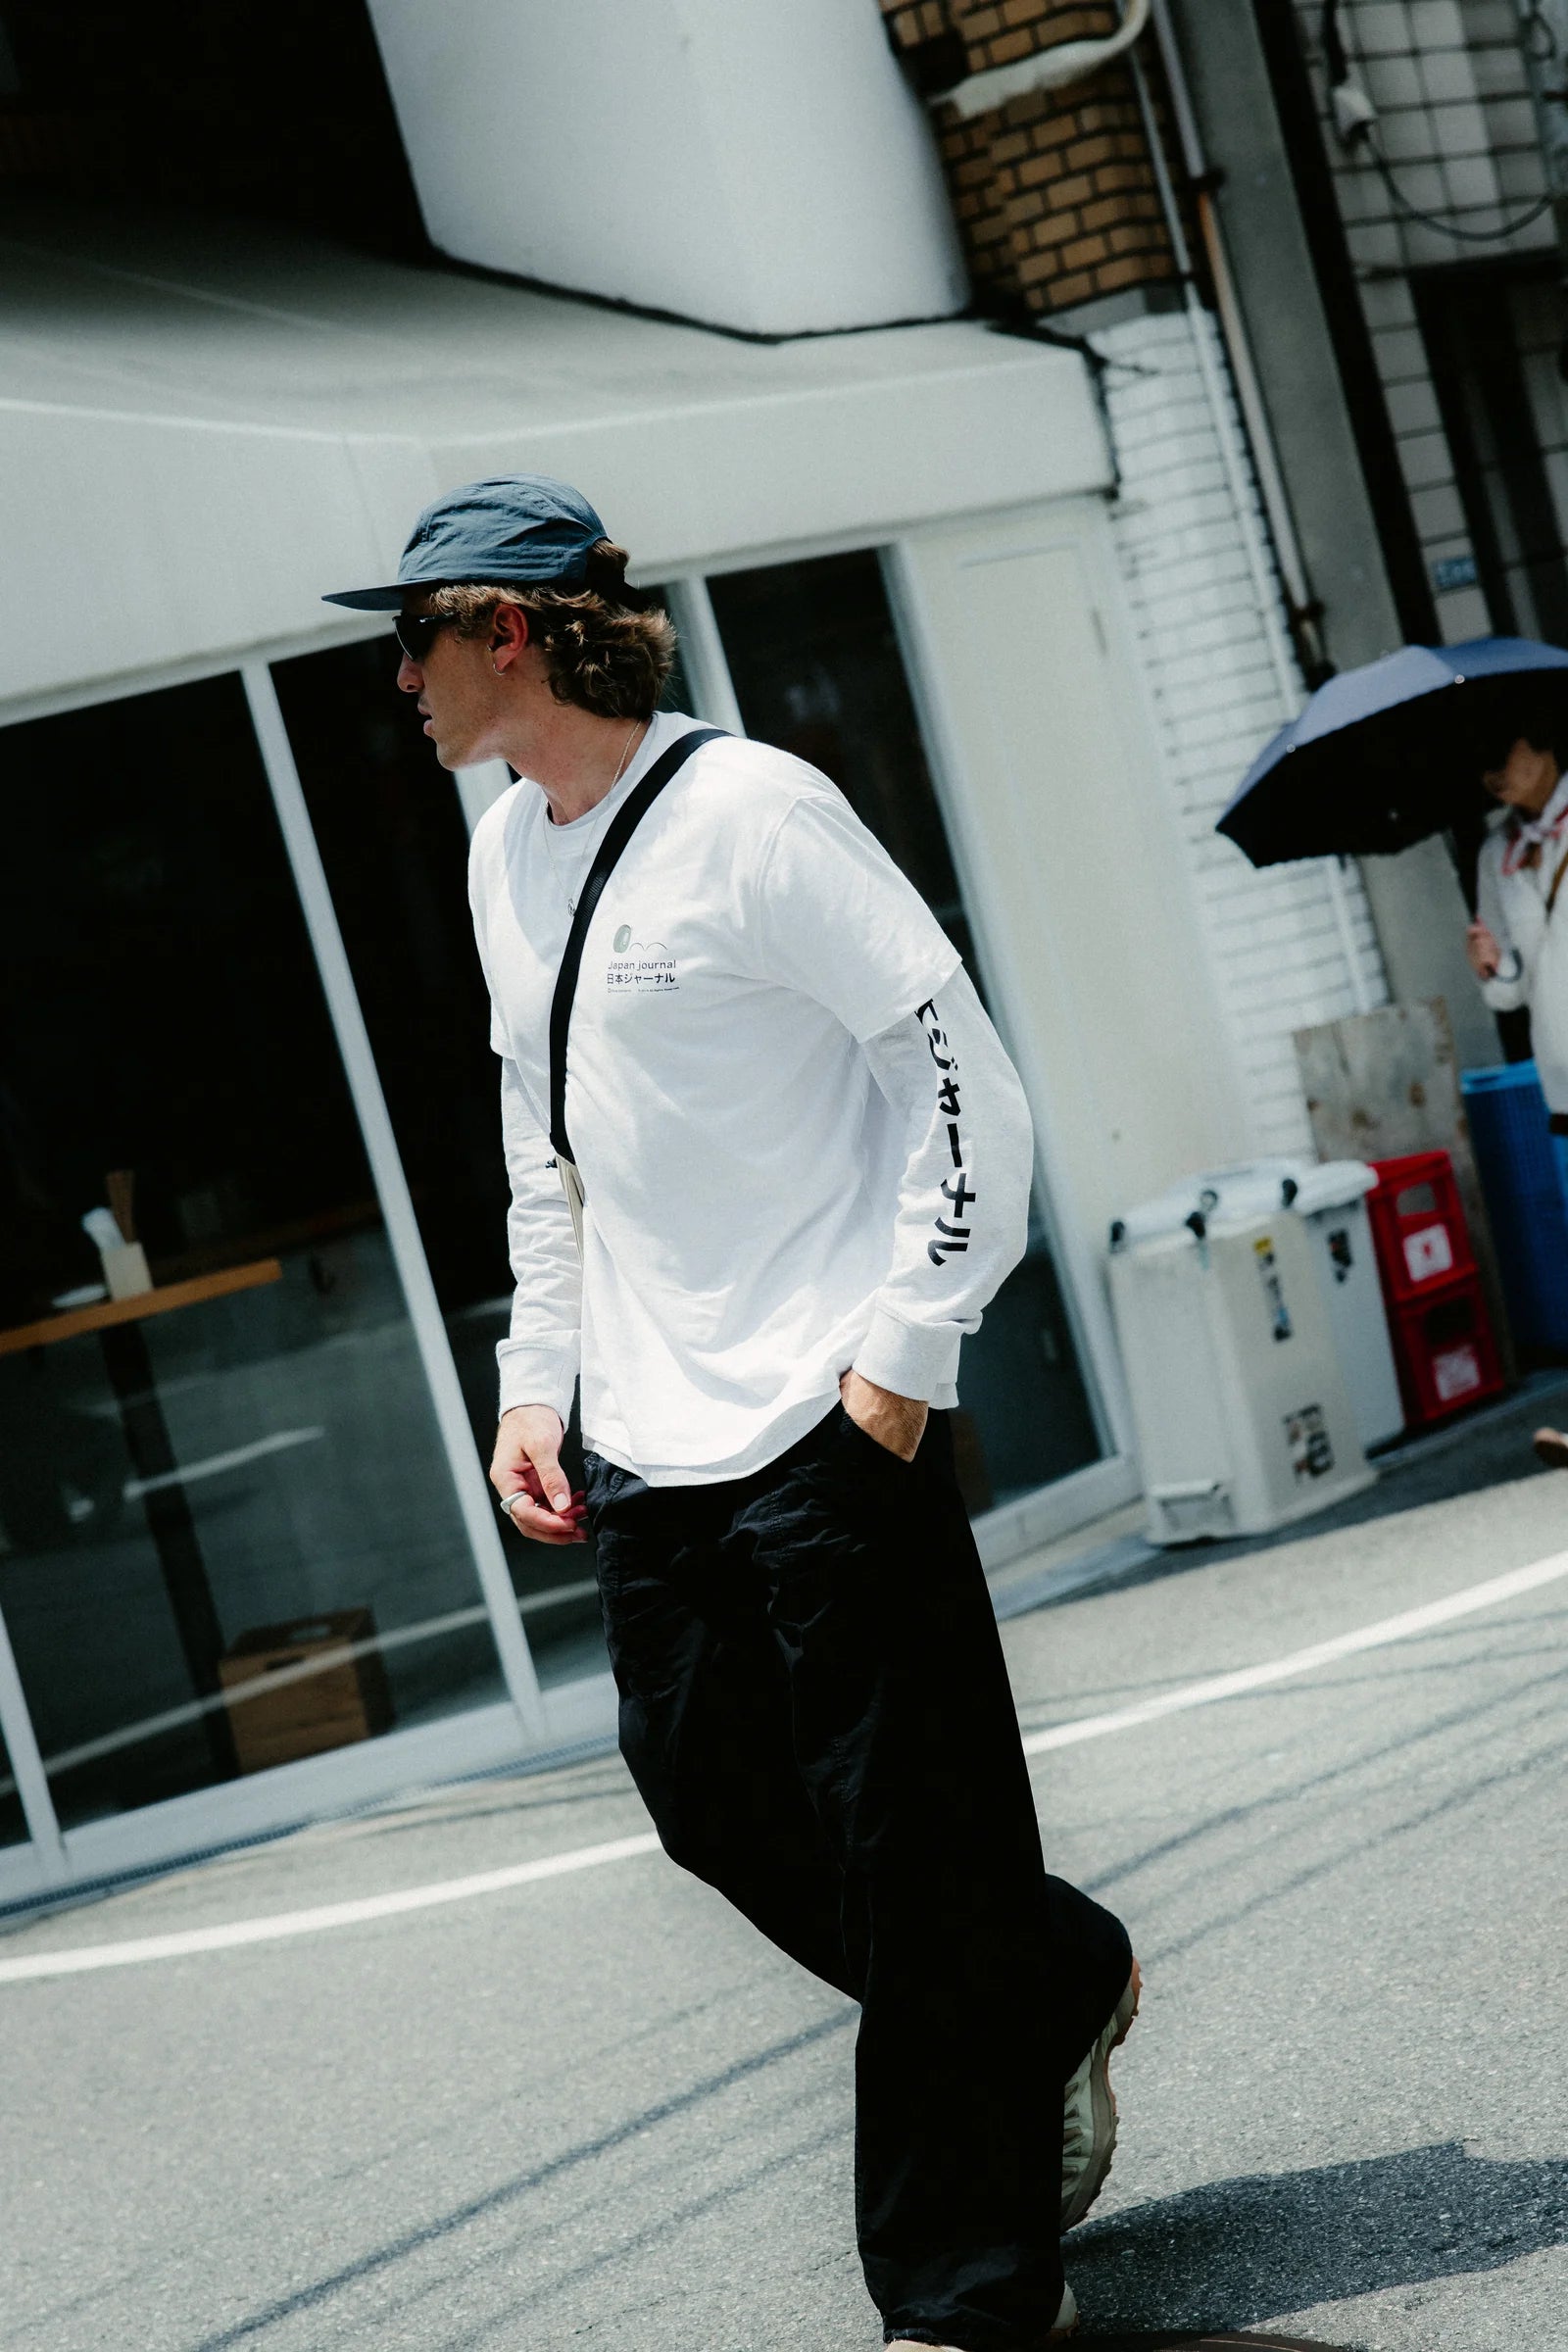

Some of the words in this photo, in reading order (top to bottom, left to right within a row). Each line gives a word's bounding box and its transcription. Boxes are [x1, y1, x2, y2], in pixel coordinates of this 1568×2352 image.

[608, 960, 635, 971] Japan
[607, 972, 675, 985] 日本ジャーナル
